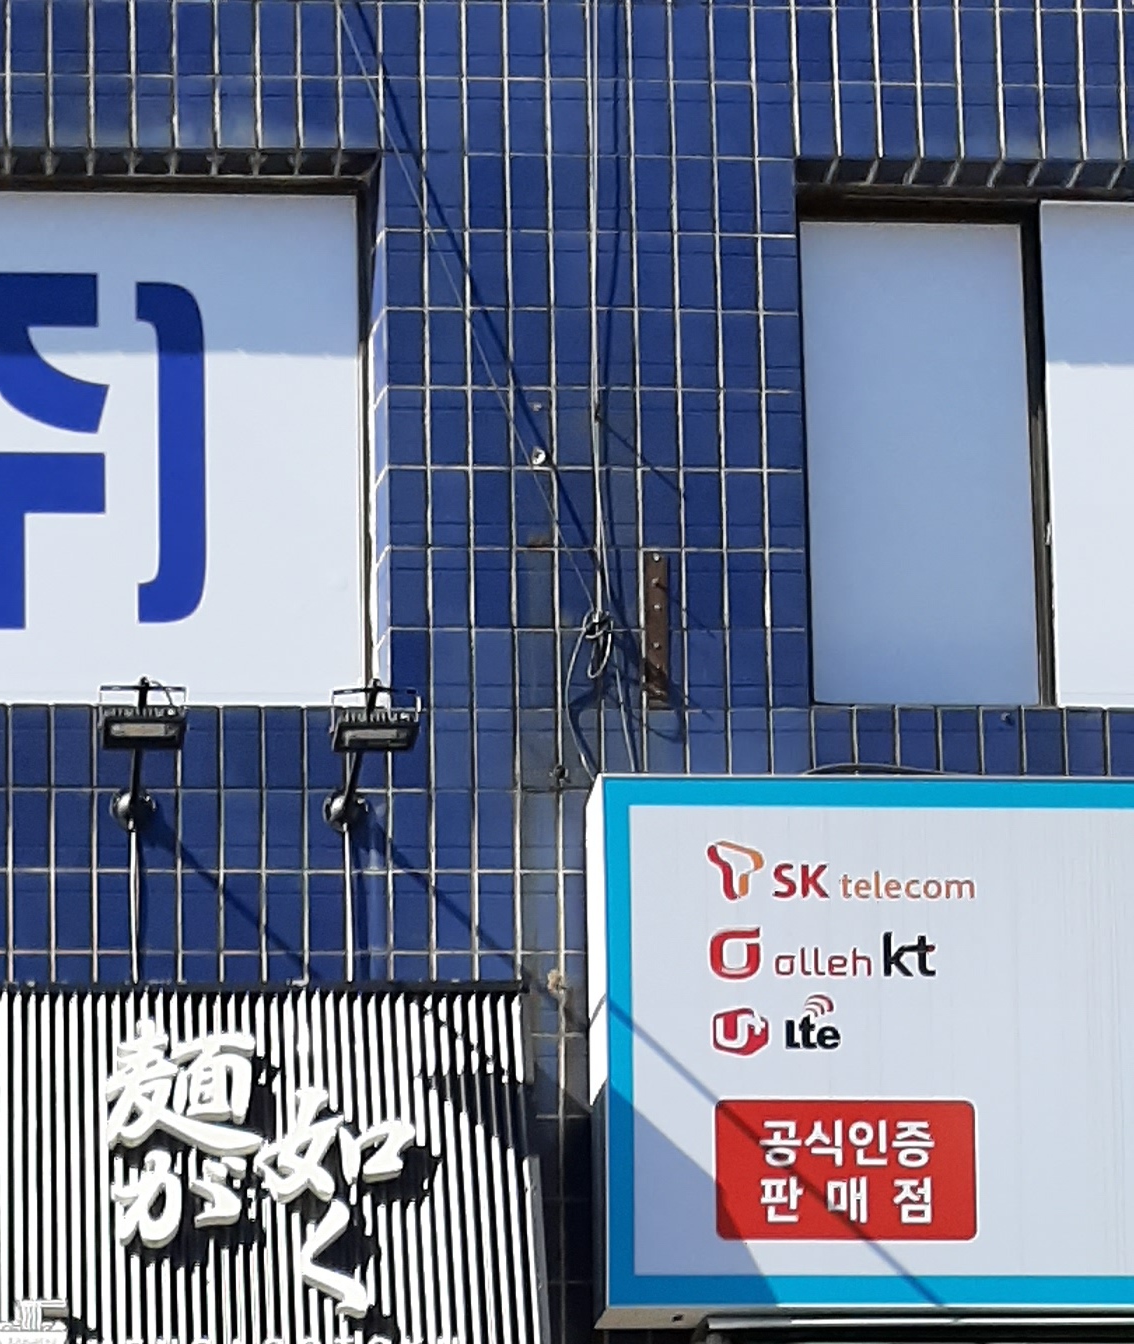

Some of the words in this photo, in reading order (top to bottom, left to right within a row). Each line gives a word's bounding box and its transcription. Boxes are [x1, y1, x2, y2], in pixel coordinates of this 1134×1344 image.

[771, 862, 830, 900] SK
[839, 871, 977, 900] telecom
[760, 1119, 935, 1168] 공식인증
